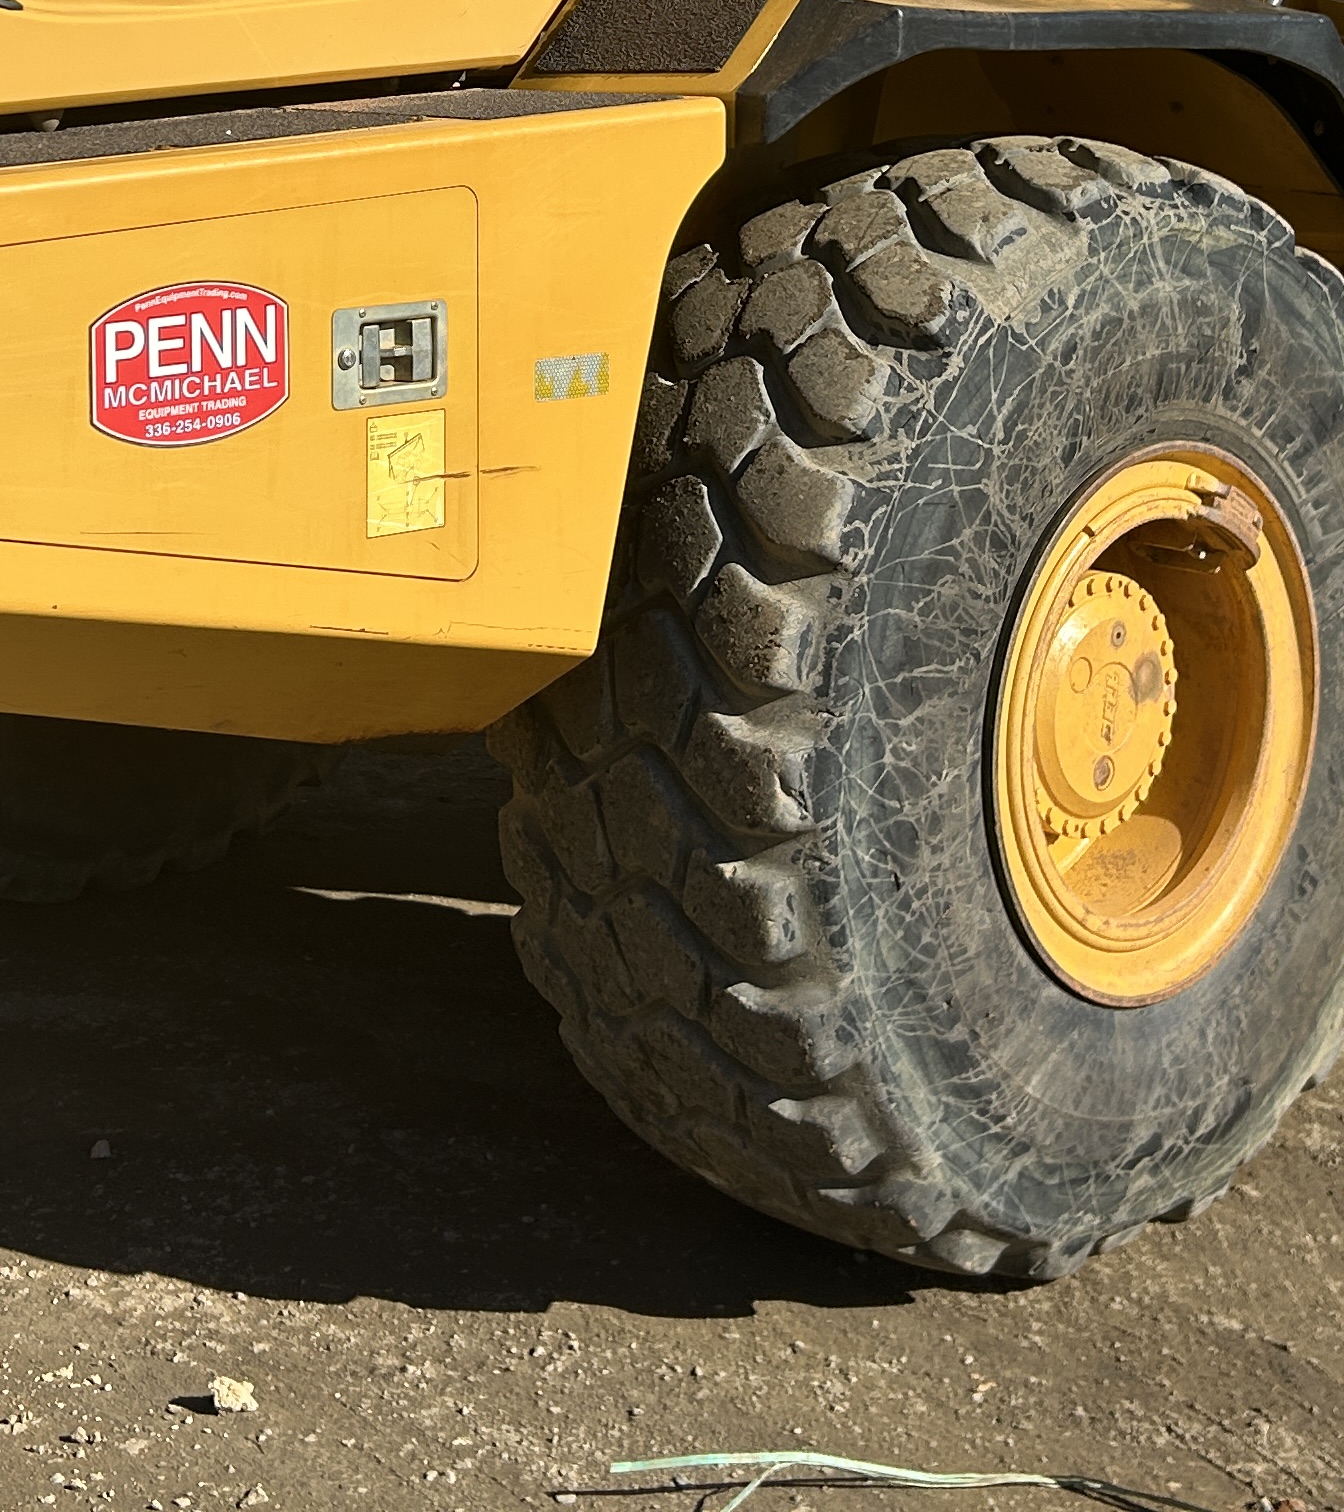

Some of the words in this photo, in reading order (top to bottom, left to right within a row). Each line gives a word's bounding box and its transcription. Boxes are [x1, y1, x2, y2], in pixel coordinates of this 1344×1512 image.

[134, 287, 248, 313] PennEquipmentTrading.com
[104, 303, 277, 385] PENN
[104, 366, 279, 409] MCMICHAEL
[138, 402, 201, 420] EQUIPMENT
[201, 396, 247, 414] TRADING
[145, 412, 241, 438] 336-254-0906
